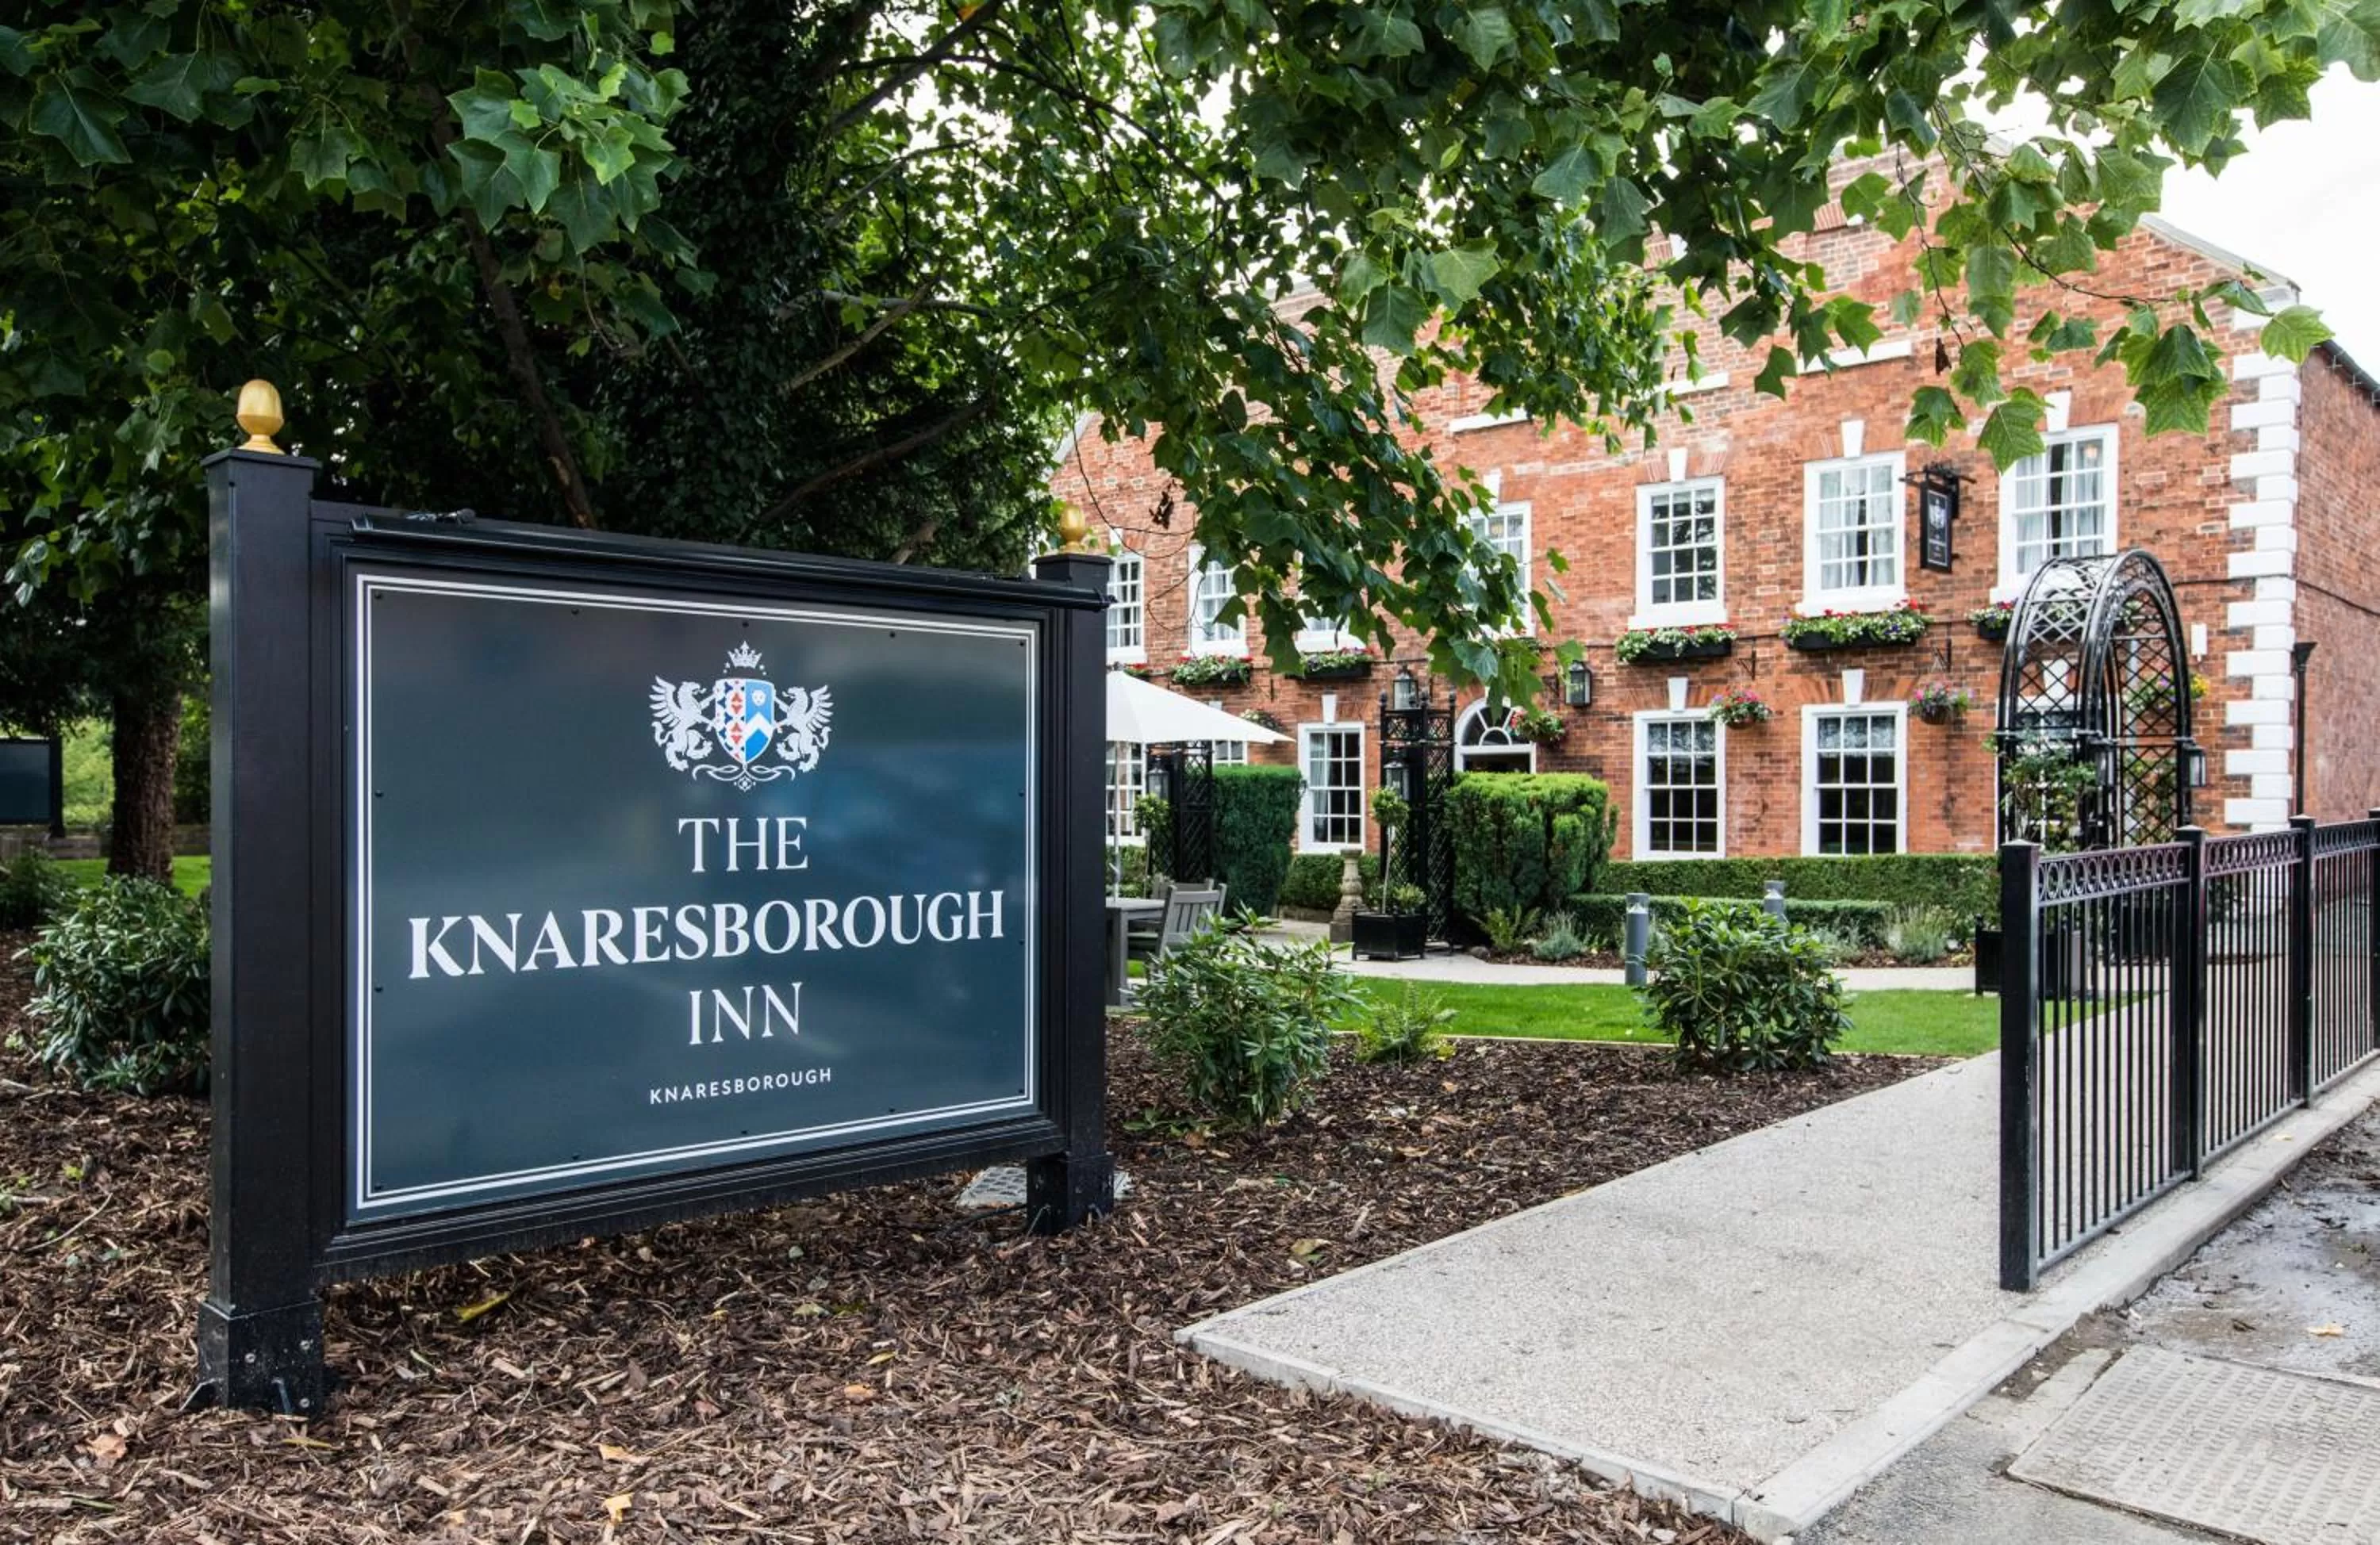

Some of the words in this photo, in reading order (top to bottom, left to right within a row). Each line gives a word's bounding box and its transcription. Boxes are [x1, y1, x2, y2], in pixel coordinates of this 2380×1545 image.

[678, 816, 808, 872] THE
[409, 890, 1004, 980] KNARESBOROUGH
[689, 982, 802, 1045] INN
[650, 1068, 831, 1105] KNARESBOROUGH
